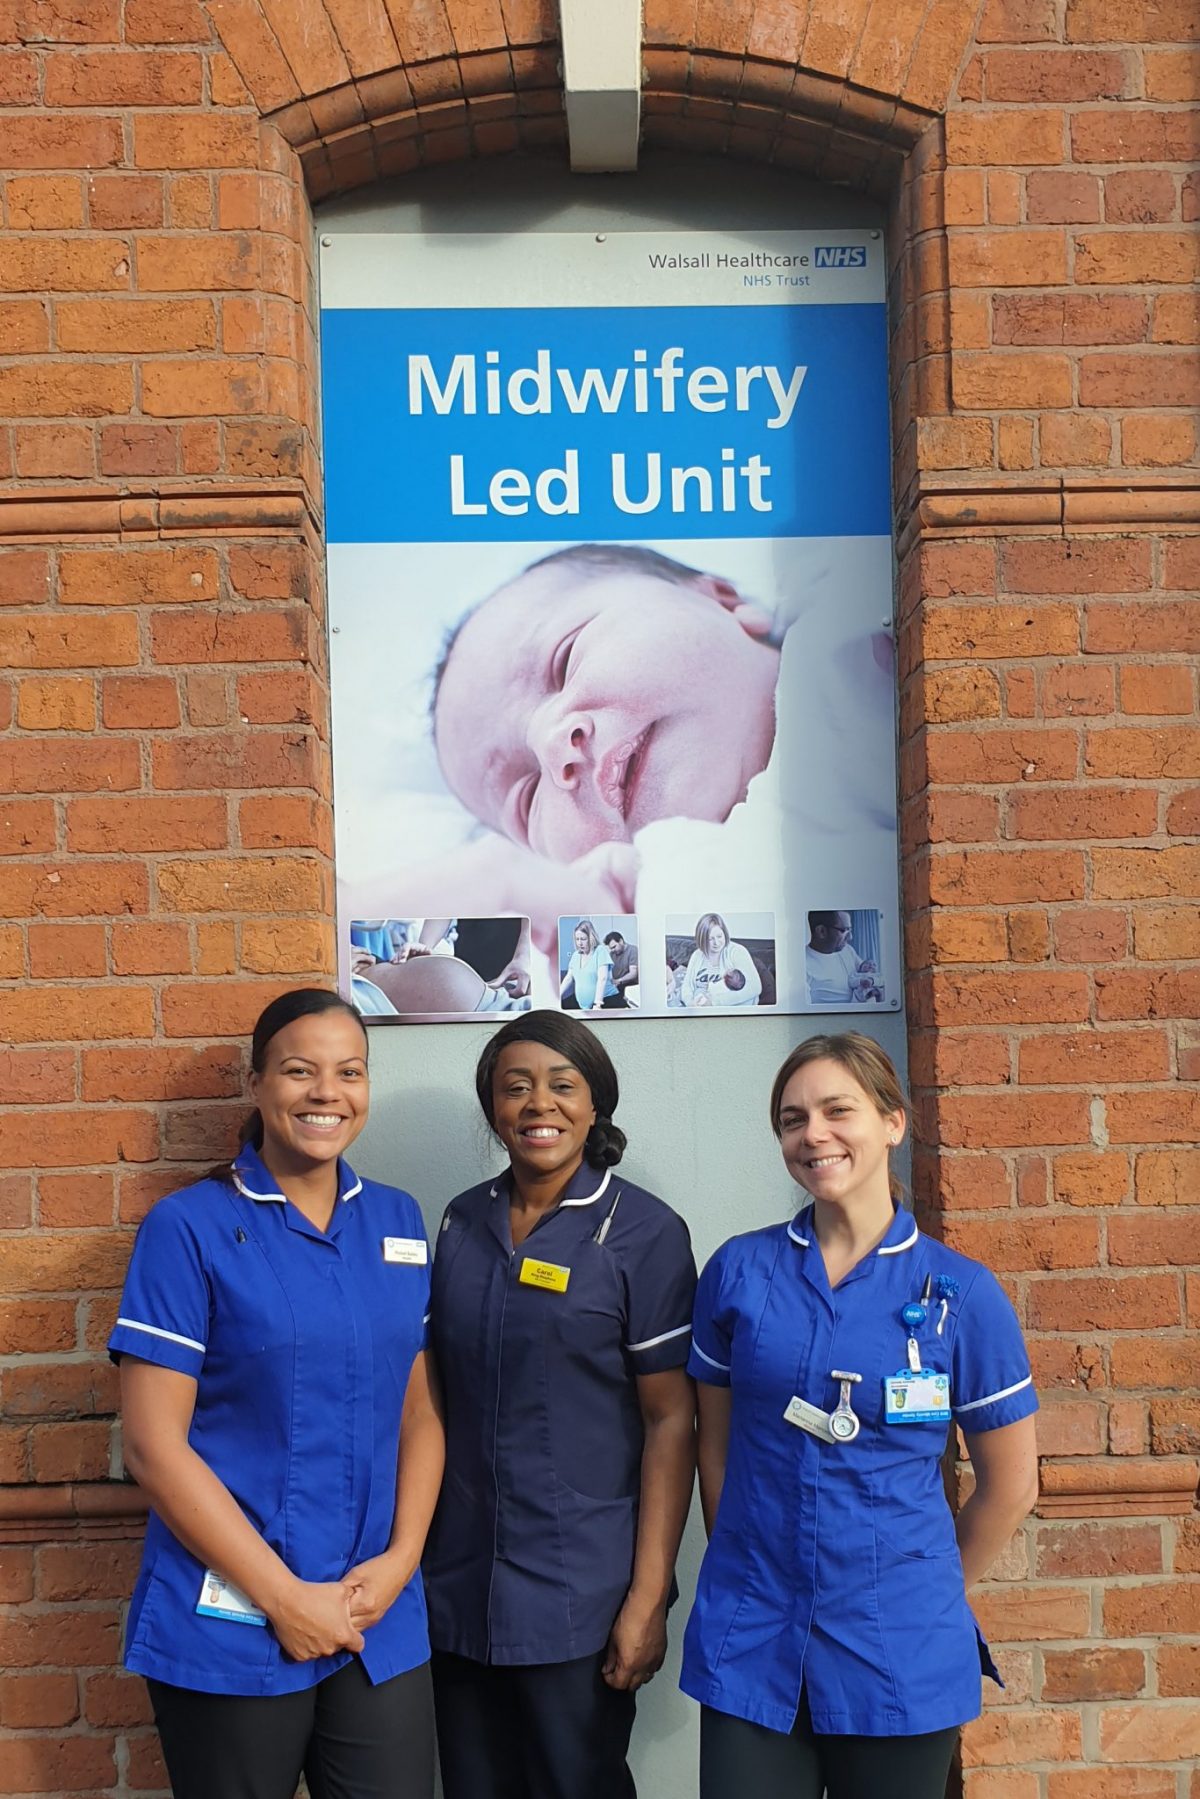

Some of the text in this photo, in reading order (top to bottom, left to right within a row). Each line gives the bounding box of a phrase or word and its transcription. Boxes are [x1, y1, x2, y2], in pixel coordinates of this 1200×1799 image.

[649, 248, 865, 268] Walsall Healthcare NHS
[743, 275, 810, 286] NHS Trust
[408, 347, 808, 429] Midwifery
[450, 448, 773, 516] Led Unit
